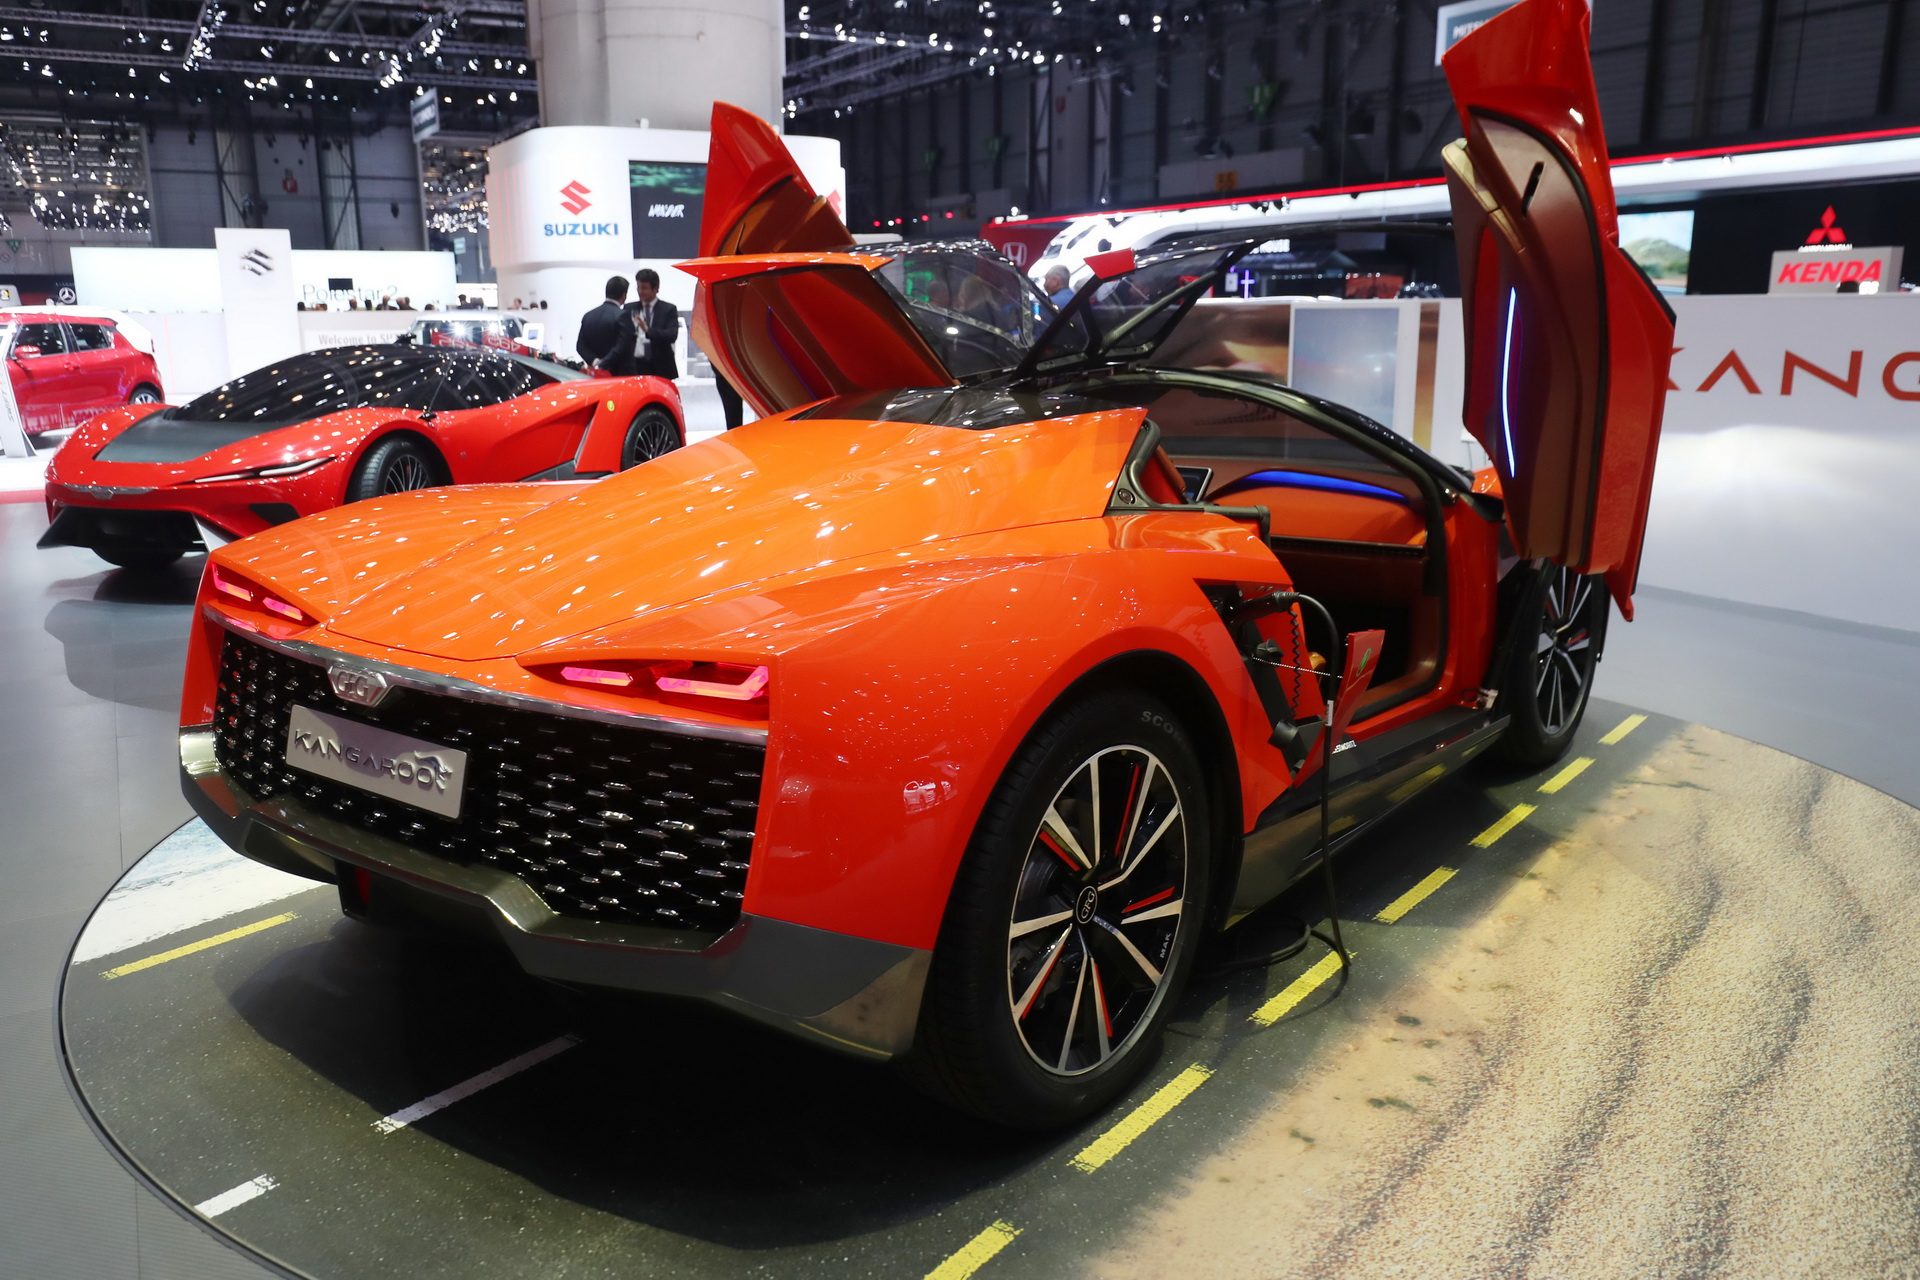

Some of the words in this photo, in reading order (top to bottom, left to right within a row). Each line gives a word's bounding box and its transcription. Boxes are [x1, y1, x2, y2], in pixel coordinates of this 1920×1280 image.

[544, 223, 619, 237] SUZUKI
[1777, 259, 1882, 284] KENDA
[318, 334, 363, 345] Welcome
[294, 728, 436, 785] KANGAROO
[1081, 891, 1096, 919] GFG
[1160, 933, 1172, 958] MAK
